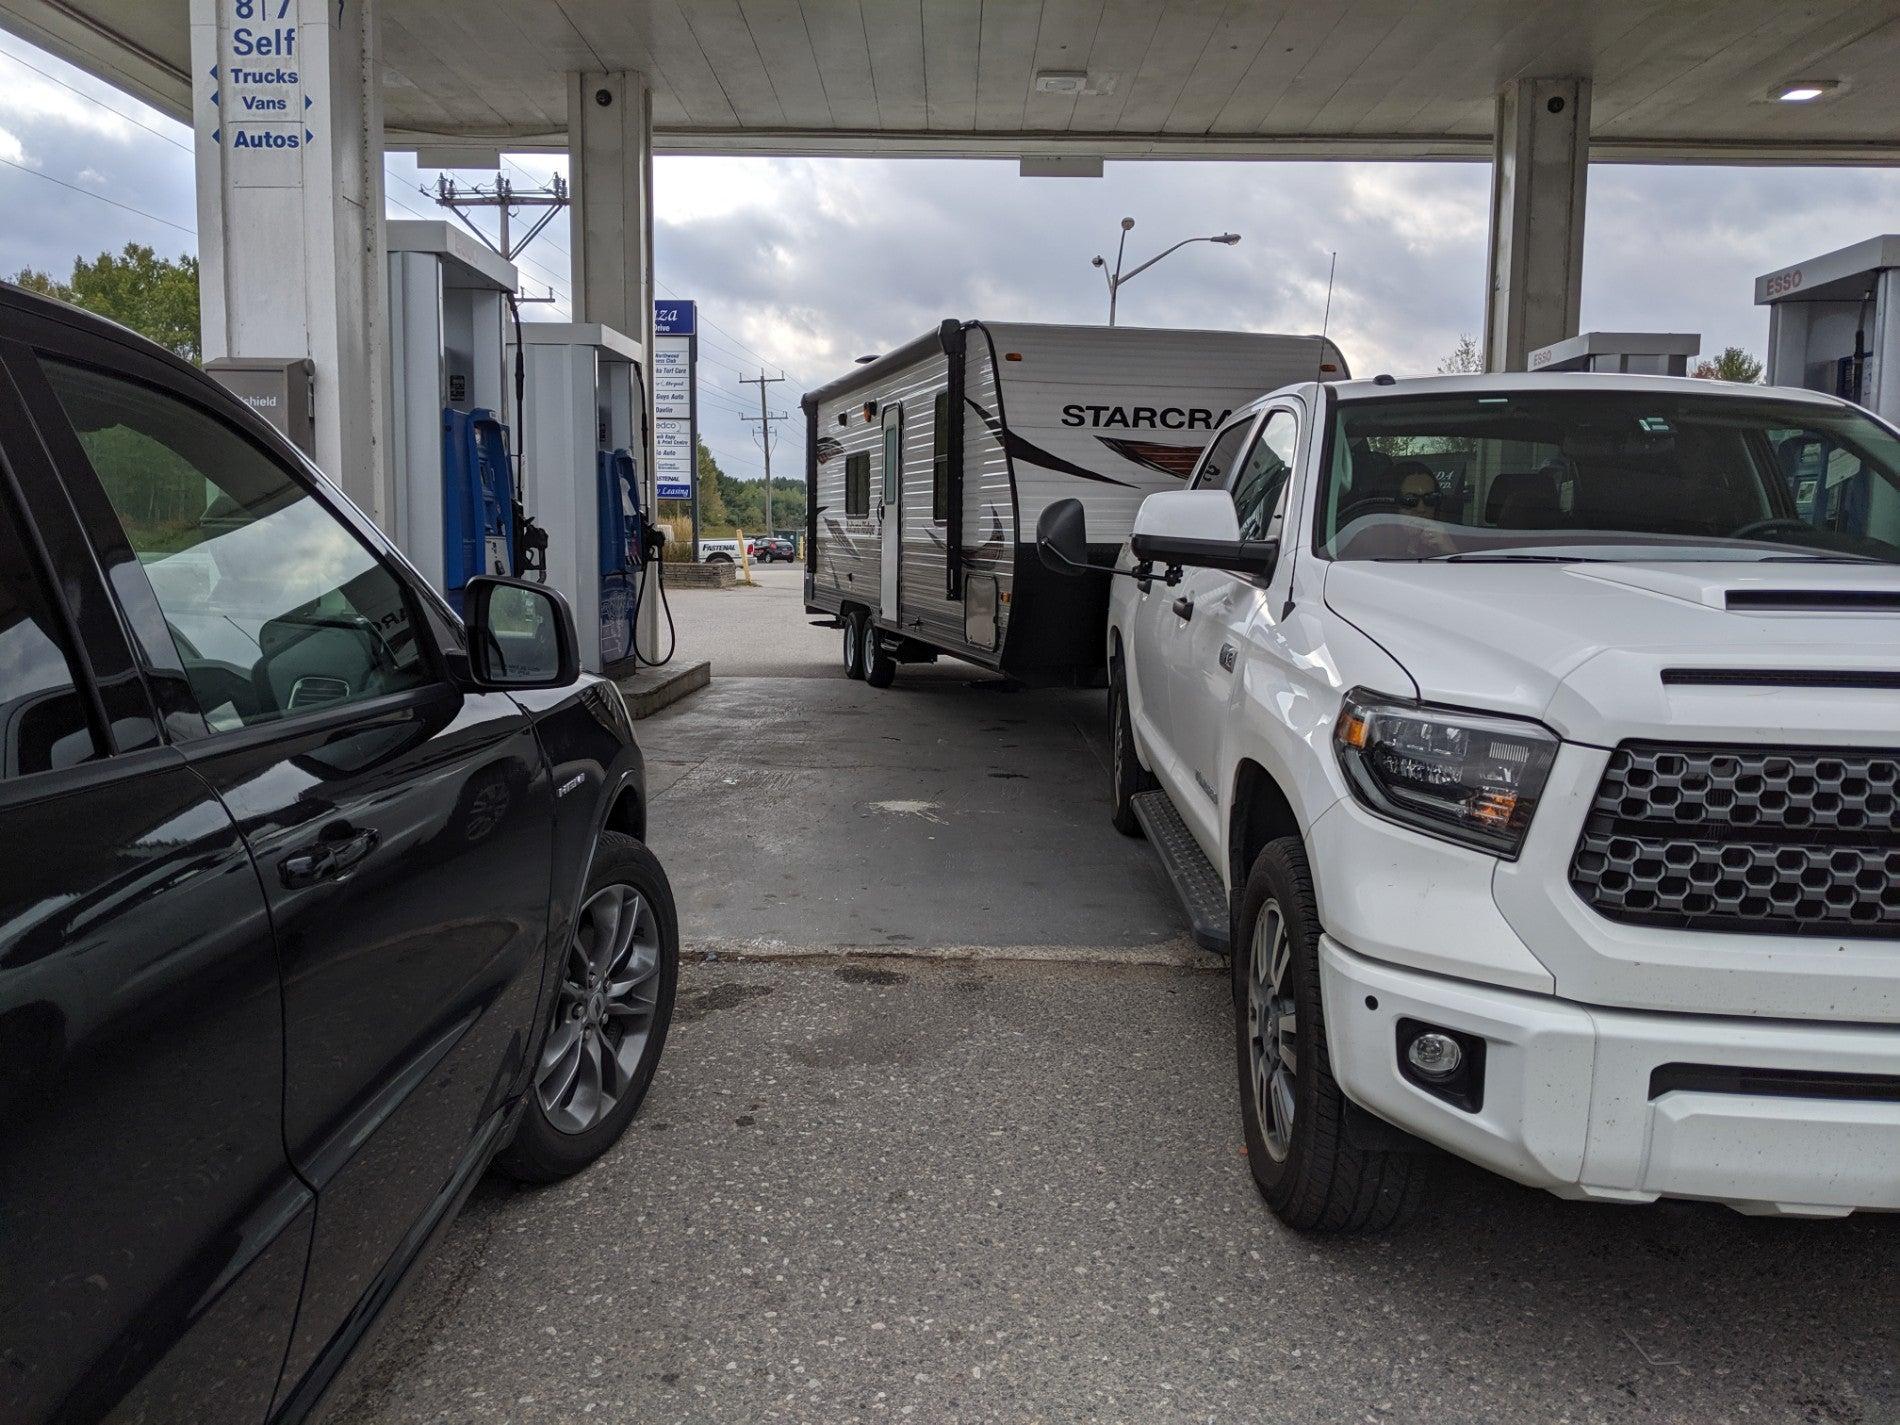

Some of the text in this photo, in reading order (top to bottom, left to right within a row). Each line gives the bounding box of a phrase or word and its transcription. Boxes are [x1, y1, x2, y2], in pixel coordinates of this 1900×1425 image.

[233, 28, 296, 56] Self
[230, 68, 299, 84] Trucks
[241, 95, 287, 110] Vans
[233, 130, 300, 149] Autos
[1766, 269, 1803, 297] ESSO
[1533, 350, 1553, 367] ESSO
[662, 487, 688, 498] Leasing
